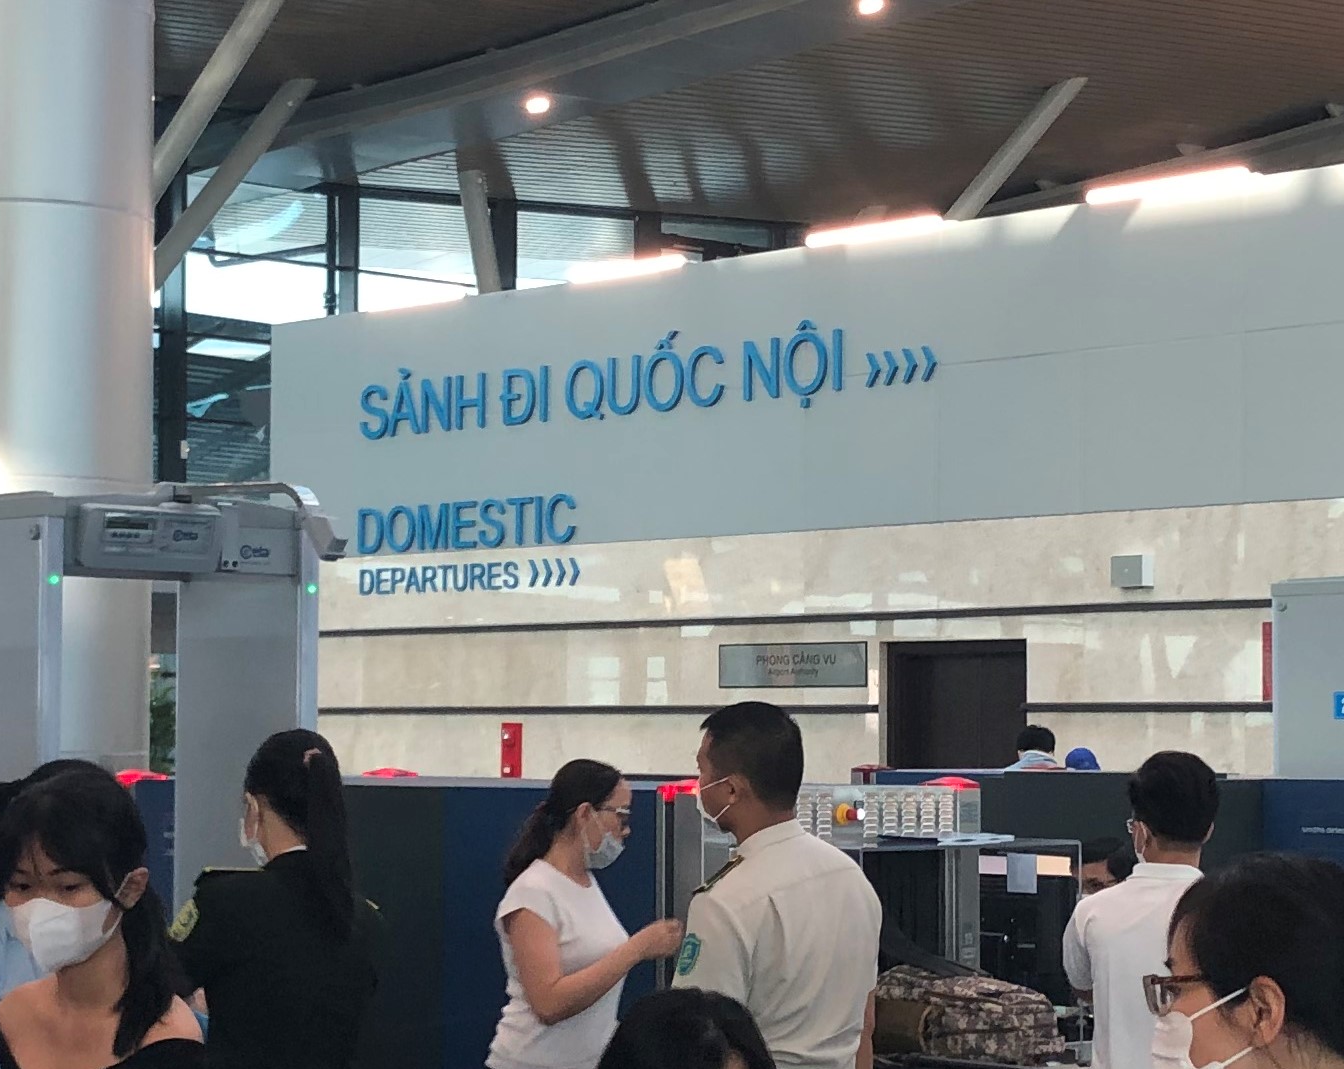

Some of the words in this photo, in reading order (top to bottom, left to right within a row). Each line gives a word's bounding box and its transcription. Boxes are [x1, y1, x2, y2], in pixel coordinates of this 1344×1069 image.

[360, 368, 487, 440] SẢNH
[499, 365, 550, 427] ĐI
[565, 330, 725, 421] QUỐC
[743, 319, 843, 408] NỘI
[358, 494, 577, 554] DOMESTIC
[359, 561, 520, 595] DEPARTURES
